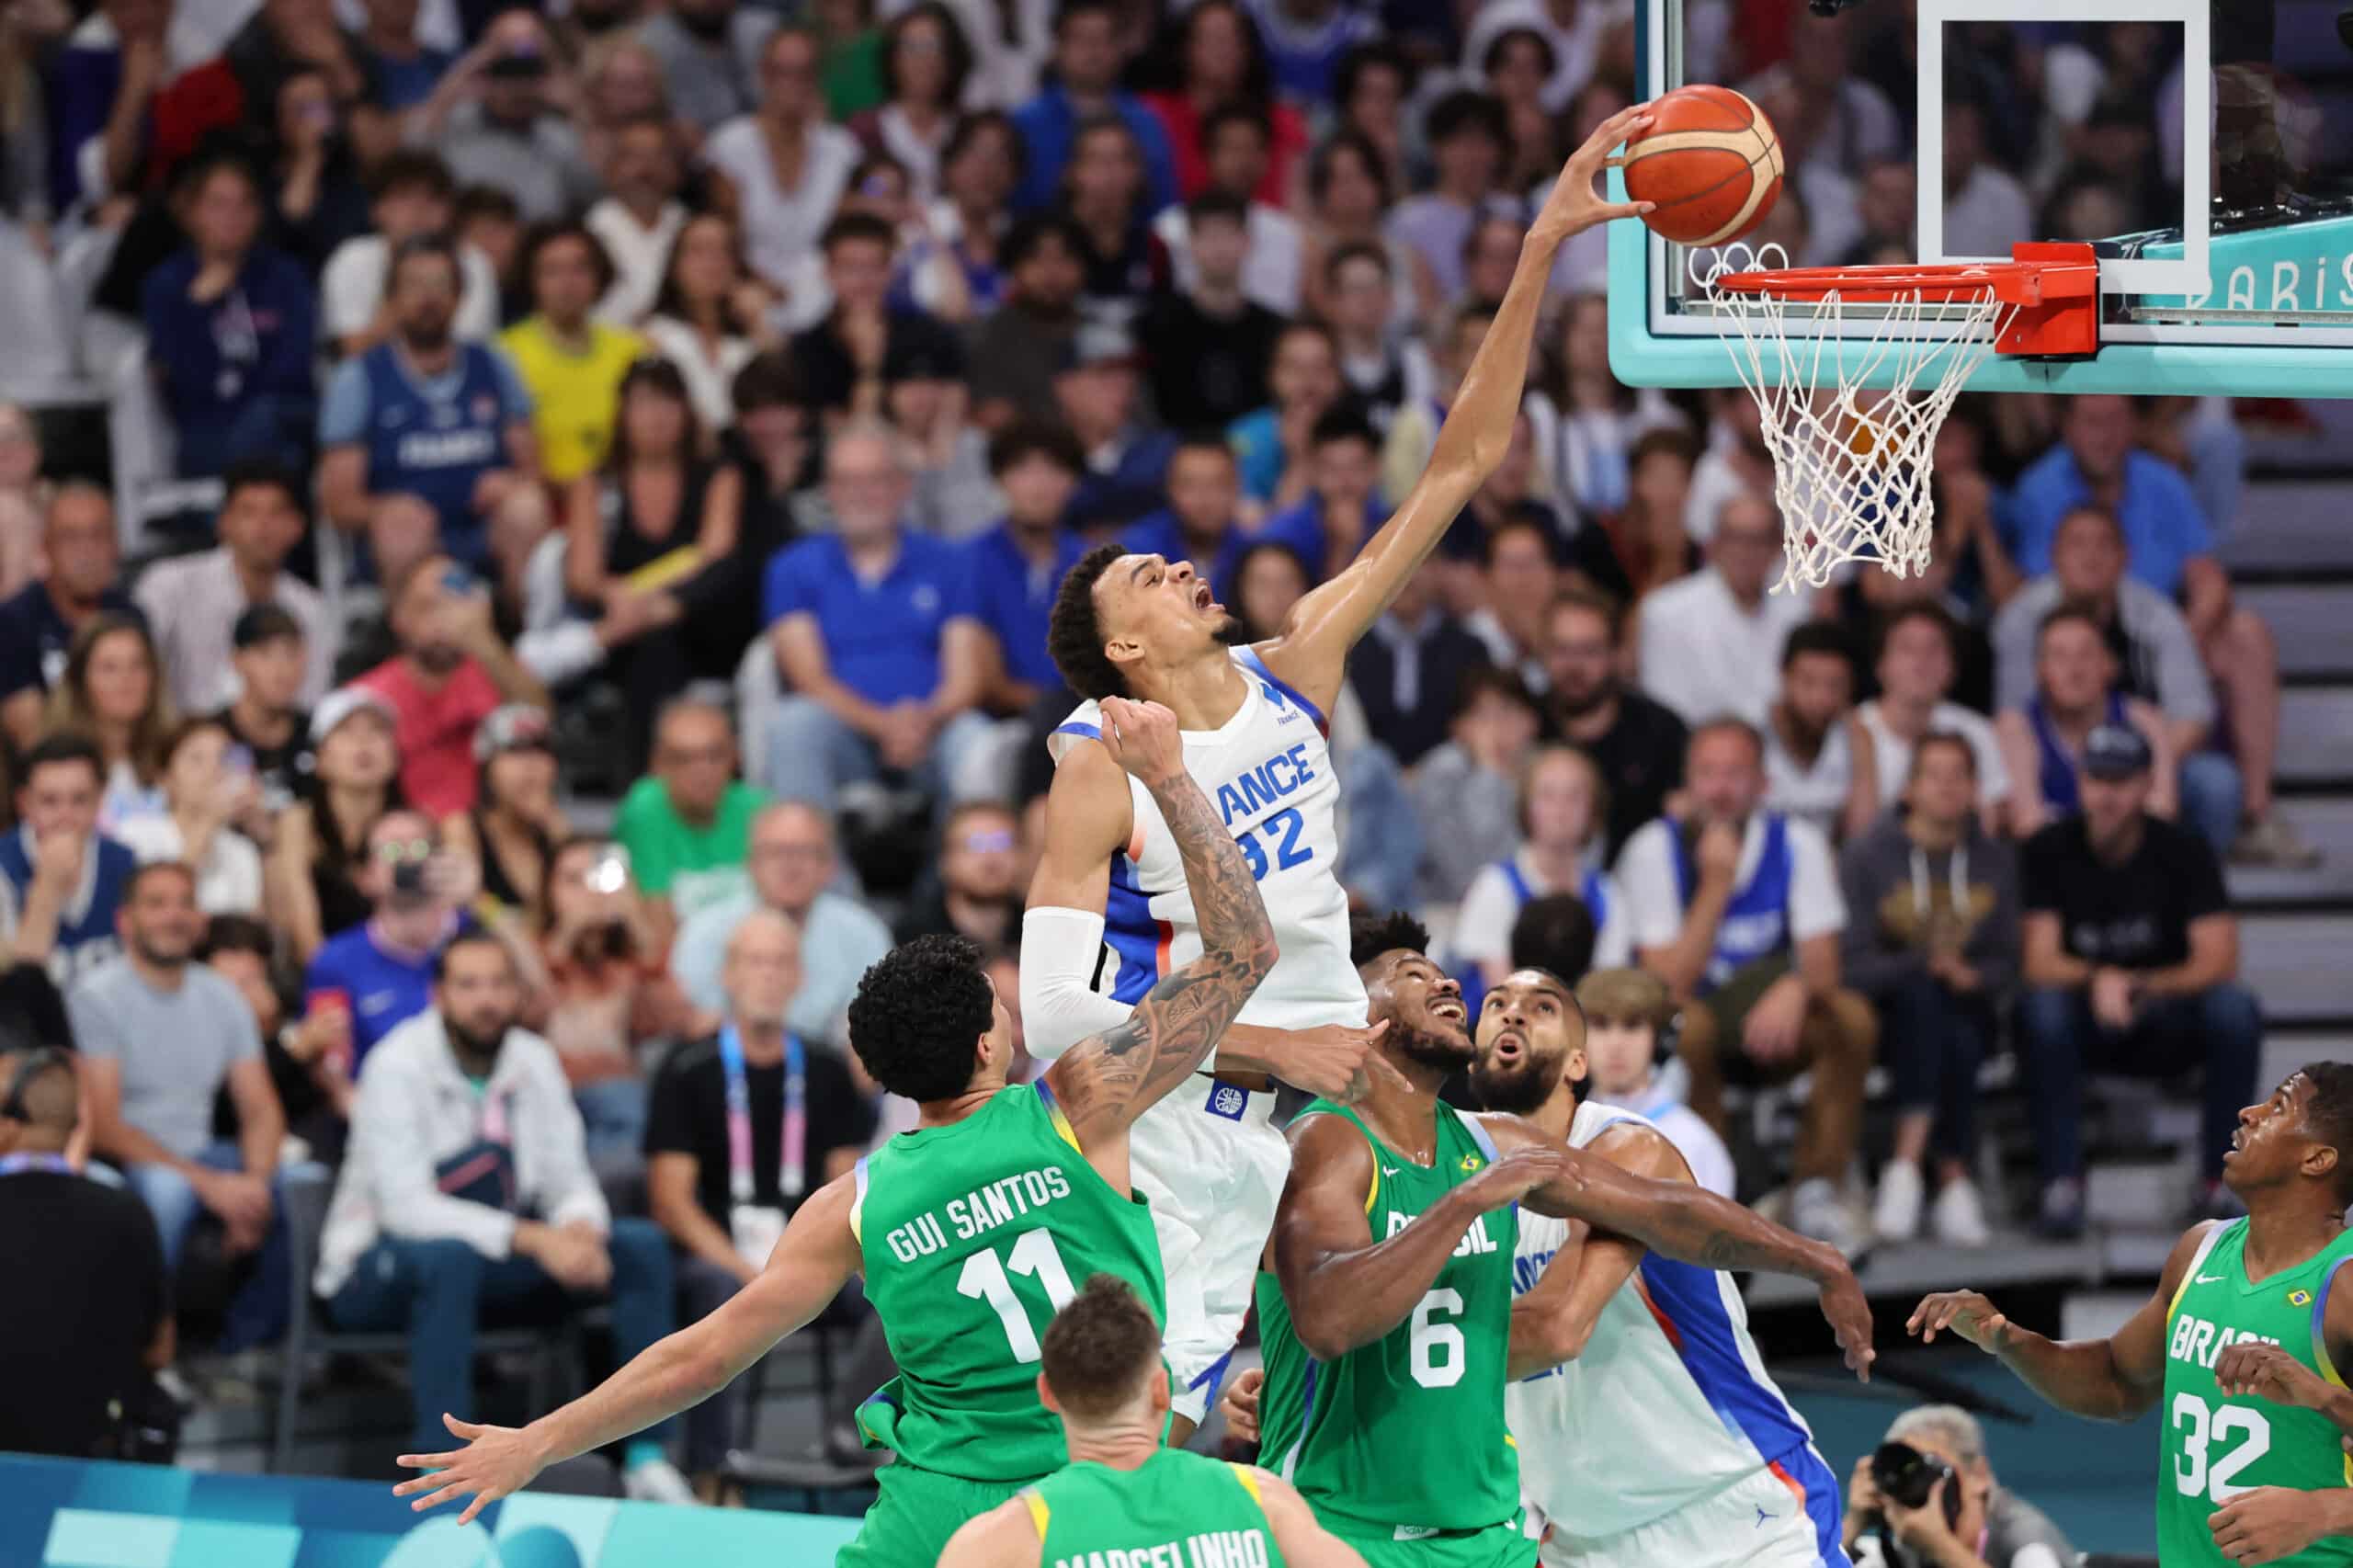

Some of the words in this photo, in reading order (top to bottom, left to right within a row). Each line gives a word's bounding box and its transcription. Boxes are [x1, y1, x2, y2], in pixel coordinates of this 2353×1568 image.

[1217, 743, 1315, 826] ANCE
[886, 1211, 949, 1263] GUI
[946, 1166, 1071, 1240] SANTOS
[957, 1227, 1077, 1364] 11
[1410, 1288, 1465, 1388] 6
[2170, 1313, 2279, 1369] BRA
[2173, 1392, 2270, 1504] 32
